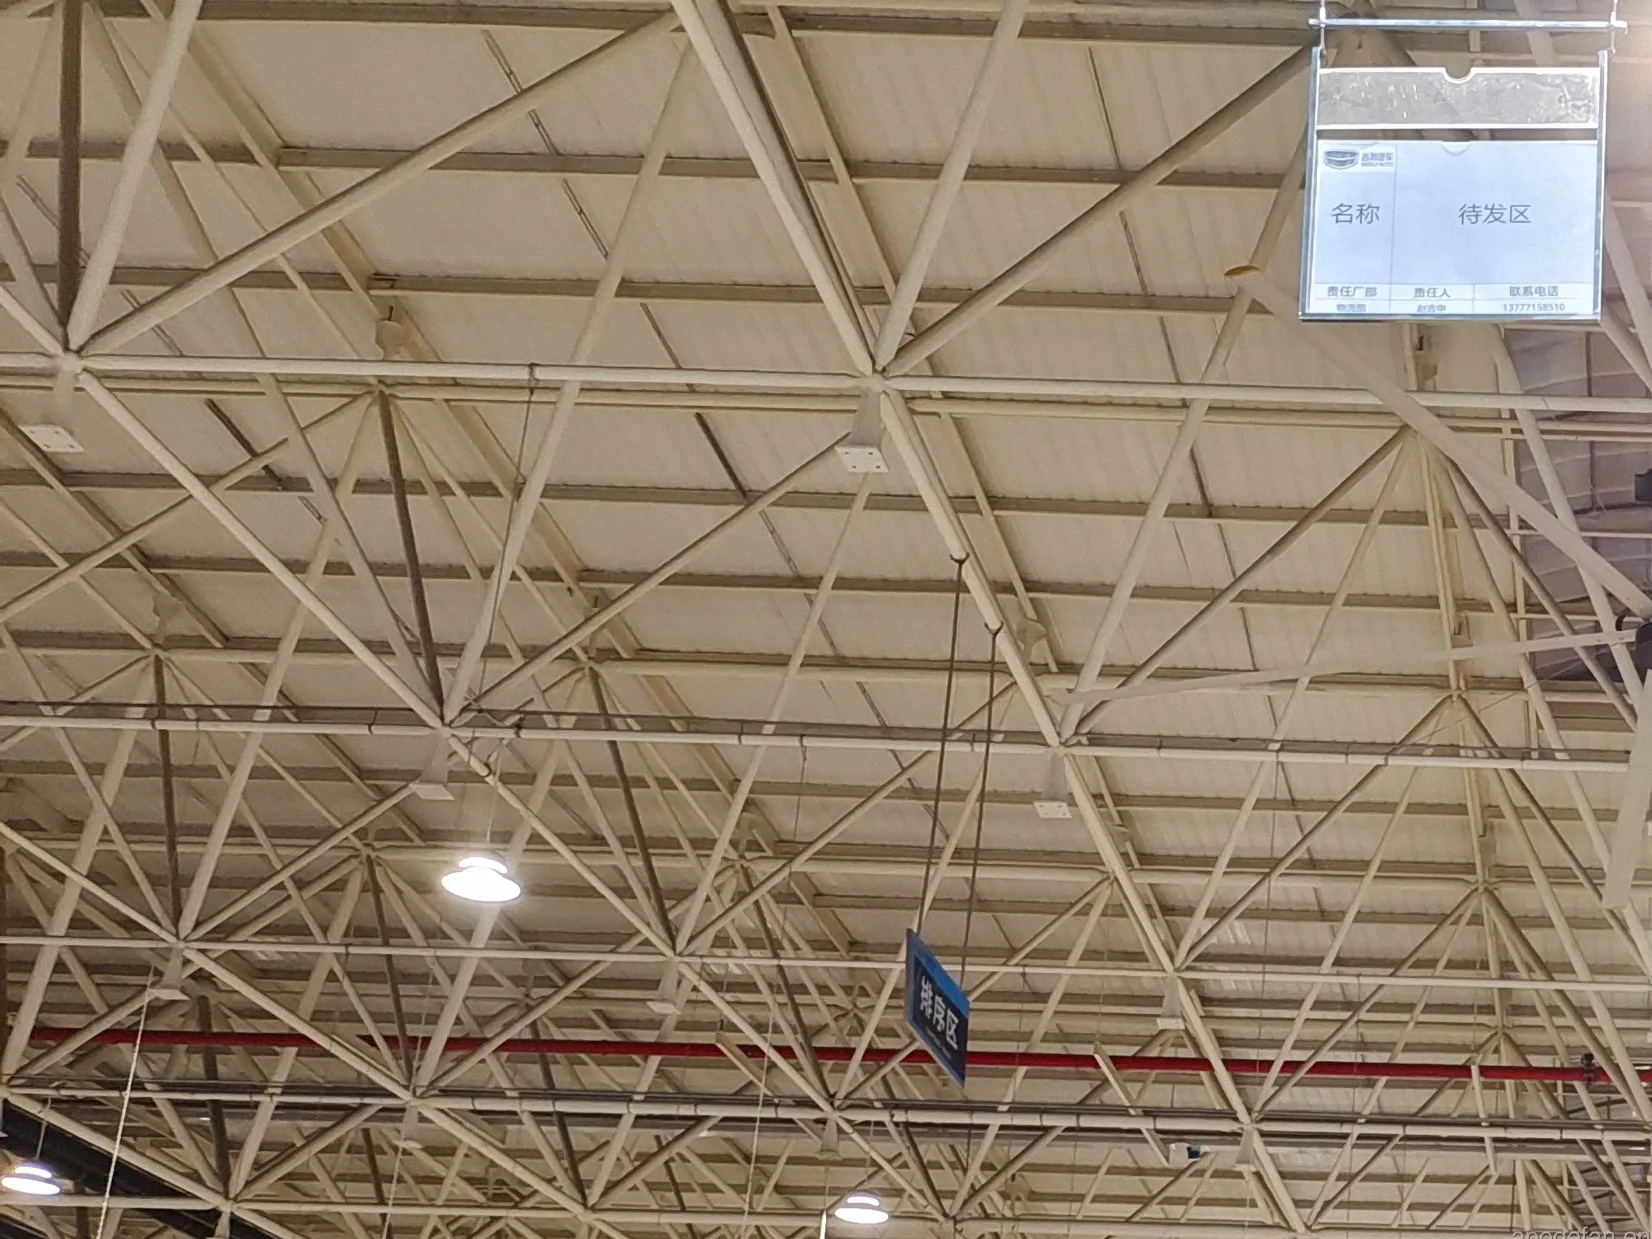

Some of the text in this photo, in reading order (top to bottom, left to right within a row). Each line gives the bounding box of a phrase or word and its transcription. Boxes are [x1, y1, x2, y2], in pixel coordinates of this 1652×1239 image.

[1331, 203, 1380, 225] 名称
[1458, 203, 1531, 225] 待发区
[1414, 287, 1451, 298] 责任人
[1509, 285, 1559, 297] 联系电话
